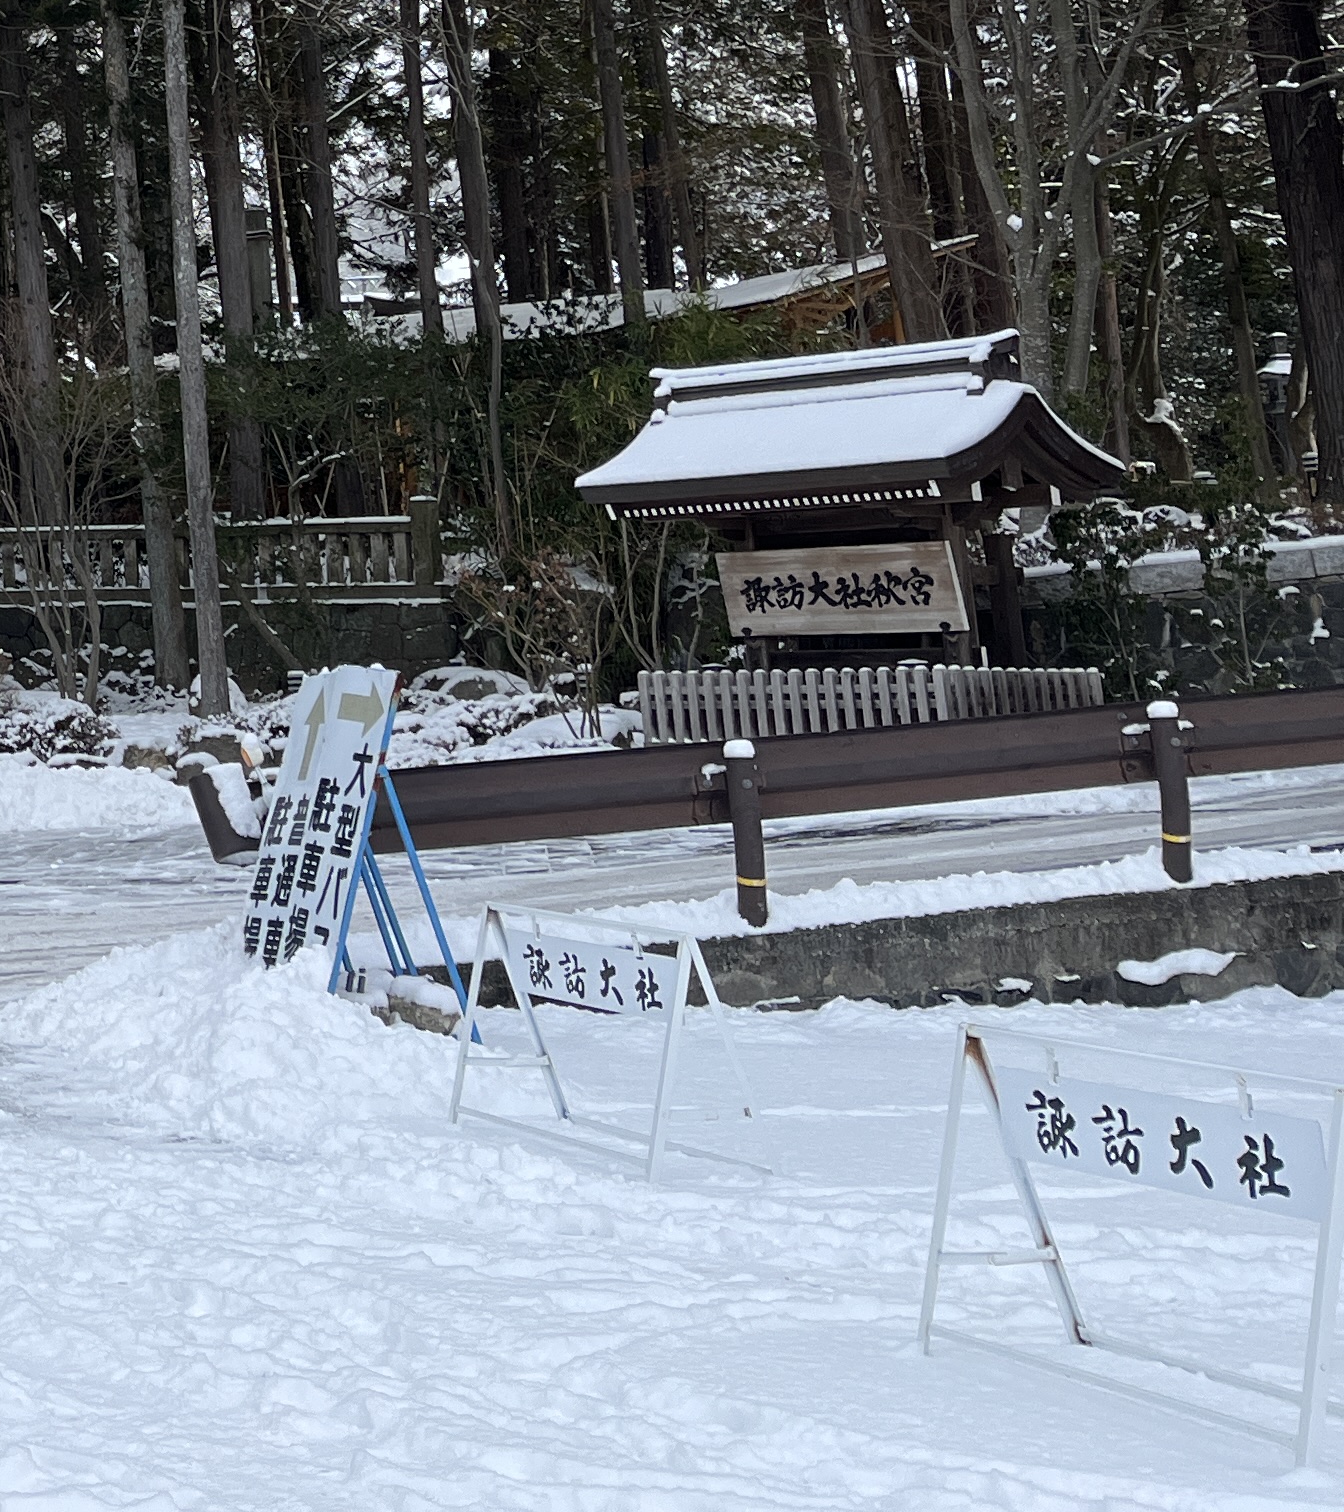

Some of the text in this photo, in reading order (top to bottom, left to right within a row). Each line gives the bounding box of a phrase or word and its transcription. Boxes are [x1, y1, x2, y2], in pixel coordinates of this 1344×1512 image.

[740, 567, 934, 614] 諏訪大社秋宮
[523, 944, 663, 1011] 諏訪大社
[1025, 1090, 1291, 1199] 諏訪大社
